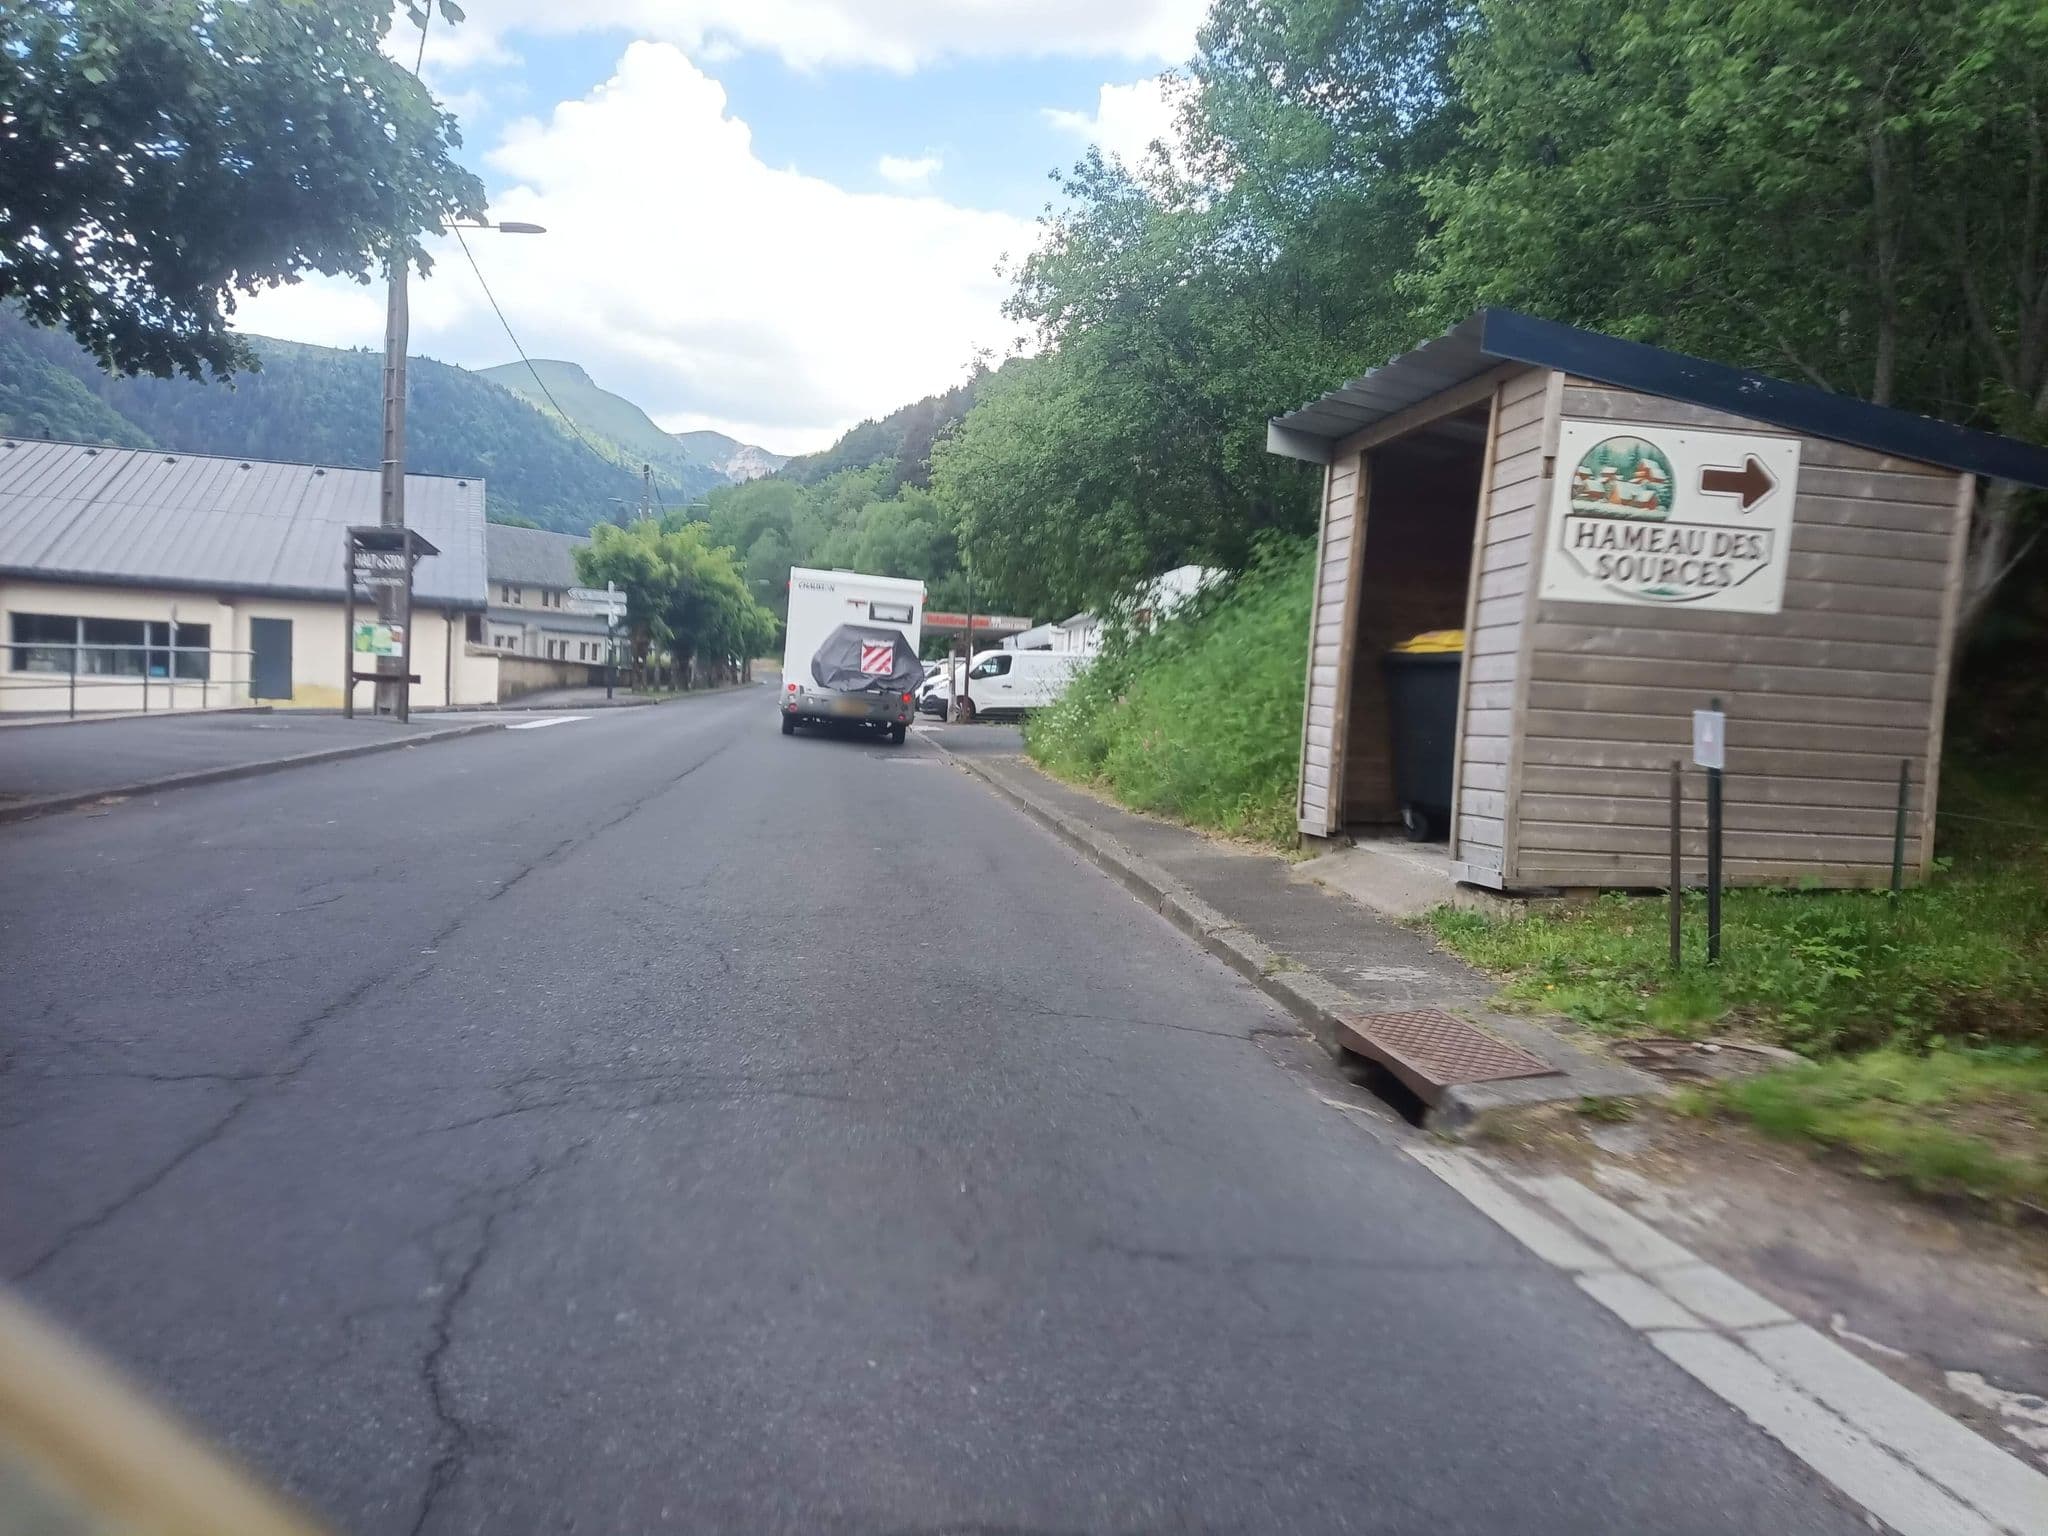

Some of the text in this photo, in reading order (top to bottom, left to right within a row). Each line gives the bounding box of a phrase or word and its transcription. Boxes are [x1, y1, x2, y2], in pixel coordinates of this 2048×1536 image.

[1575, 522, 1763, 560] HAMEAU DES
[1597, 553, 1731, 587] SOURCES
